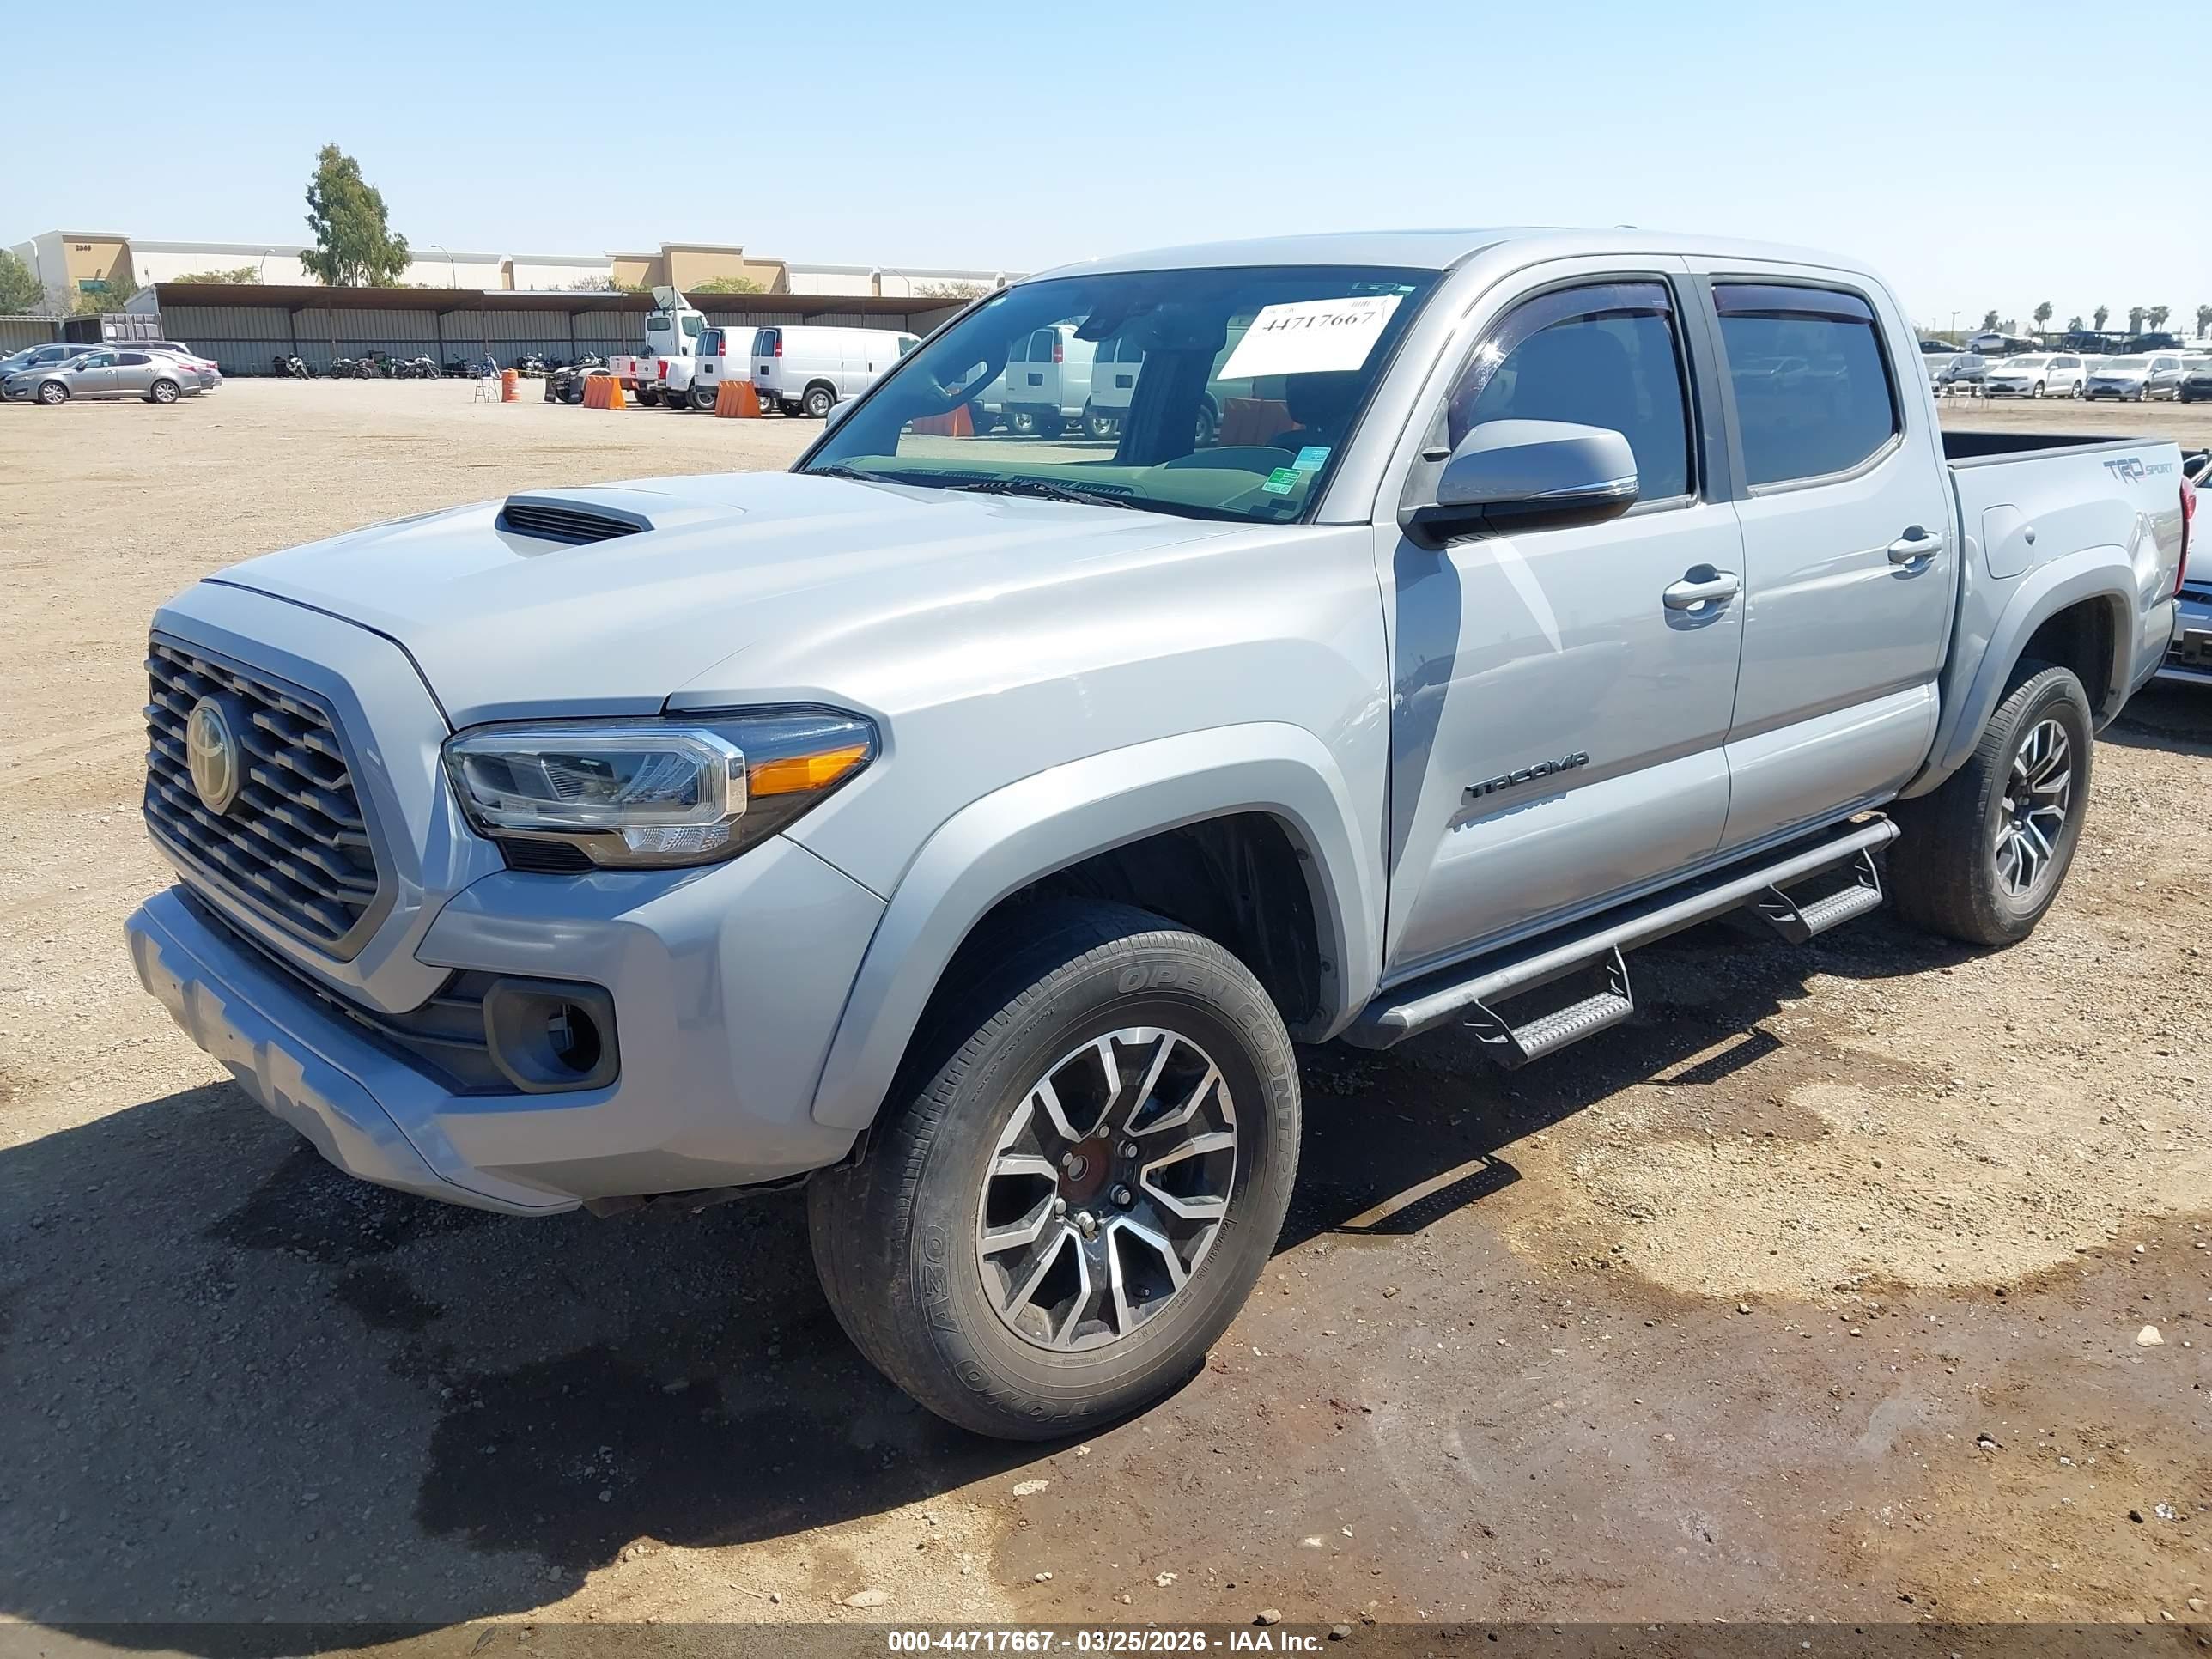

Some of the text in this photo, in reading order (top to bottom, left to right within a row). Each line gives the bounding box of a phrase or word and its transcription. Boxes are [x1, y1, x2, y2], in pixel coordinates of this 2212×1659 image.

[1262, 312, 1376, 331] 44717667
[2103, 457, 2173, 484] TRD SPORT
[1463, 750, 1589, 799] TACOMA
[1117, 964, 1293, 1205] OPEN COUNTRY
[923, 1224, 961, 1333] A30
[954, 1358, 1096, 1423] TOYO
